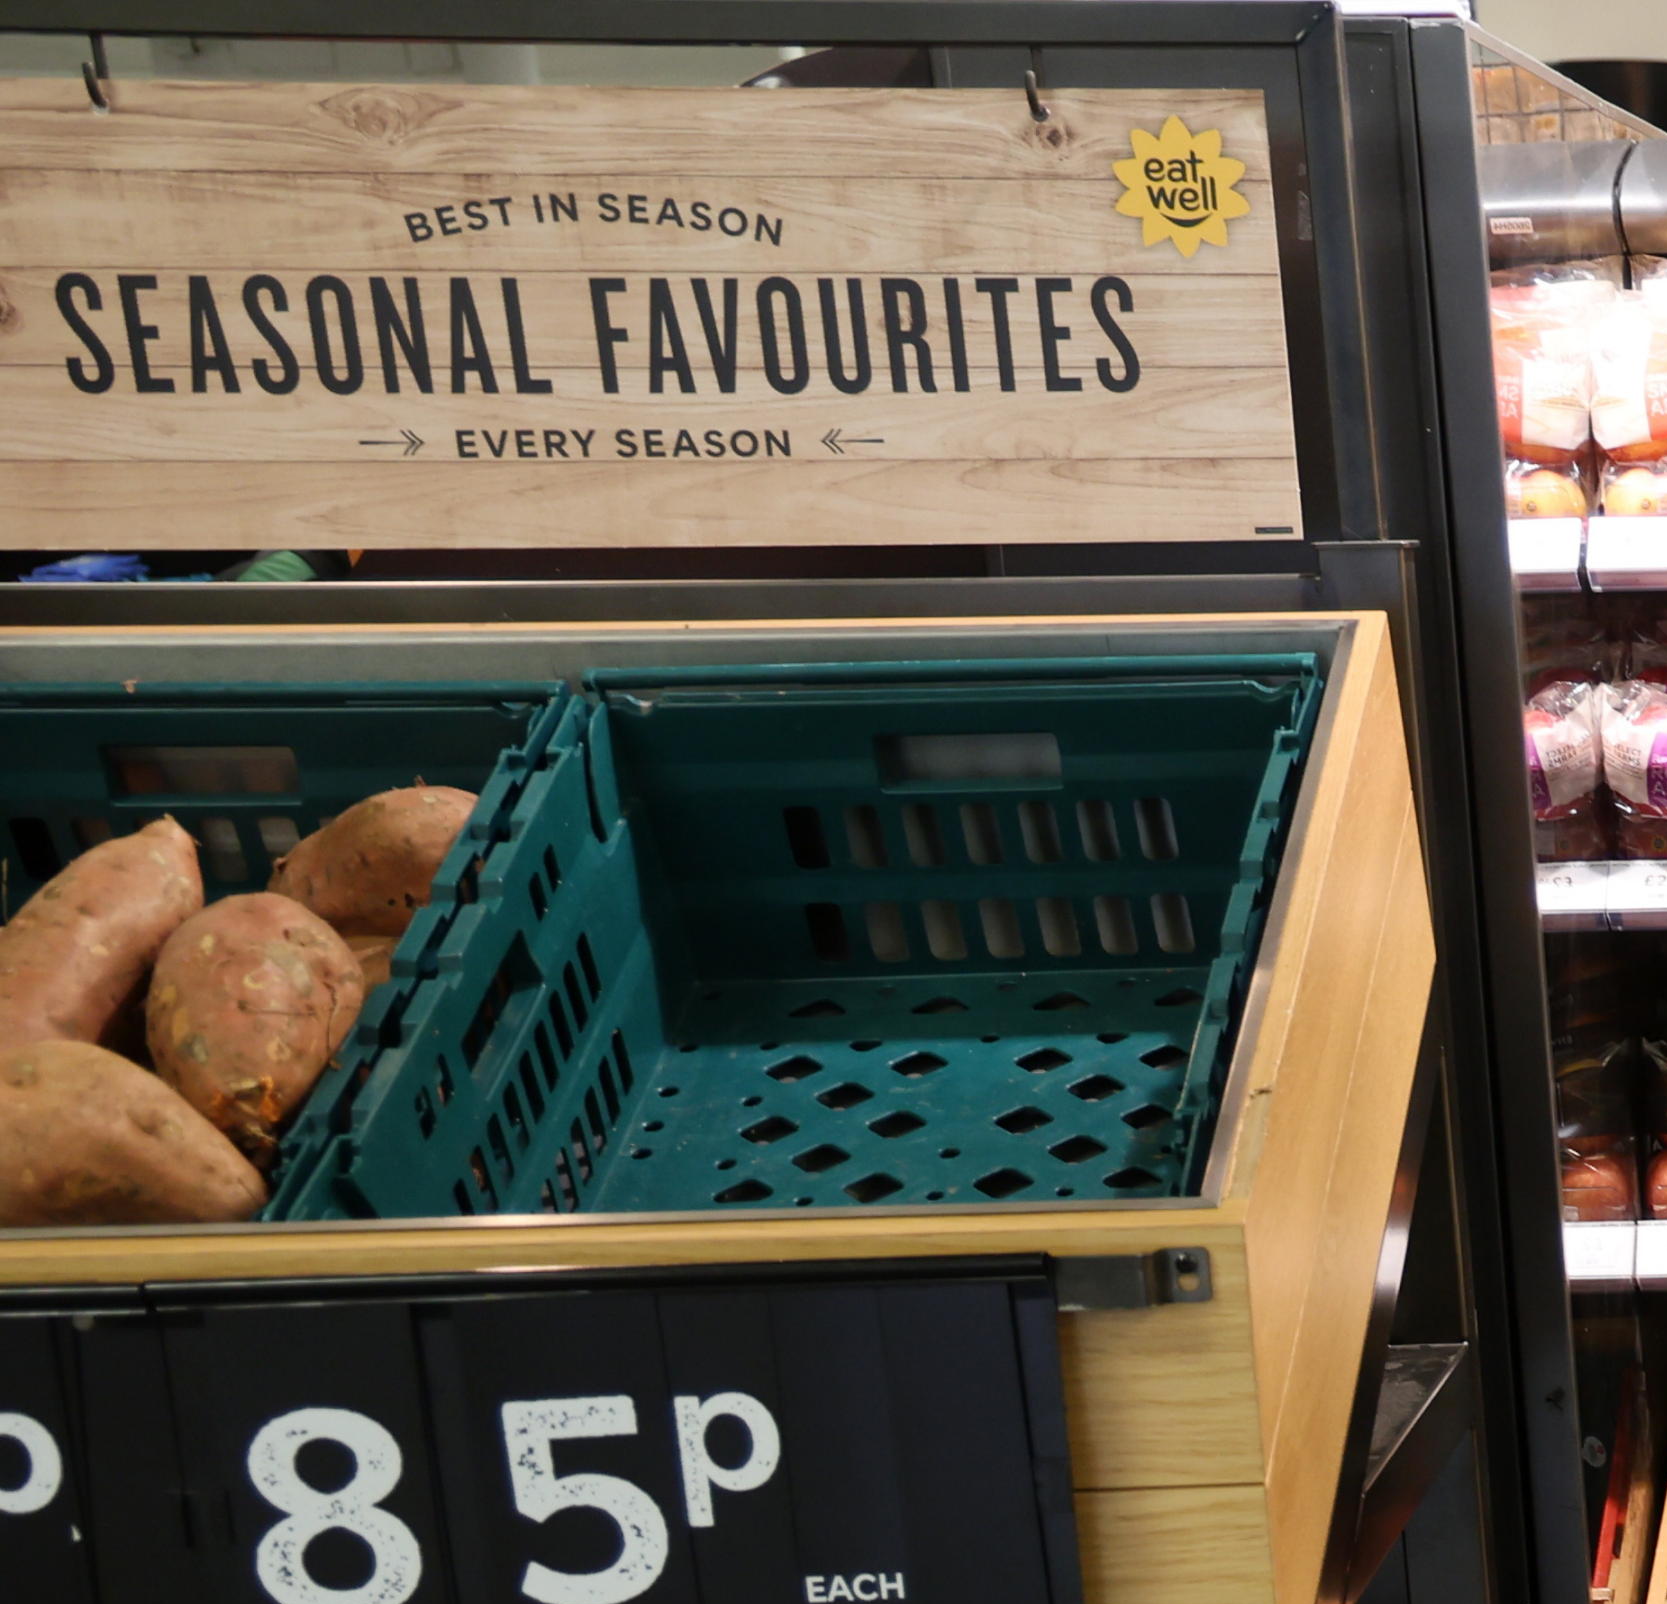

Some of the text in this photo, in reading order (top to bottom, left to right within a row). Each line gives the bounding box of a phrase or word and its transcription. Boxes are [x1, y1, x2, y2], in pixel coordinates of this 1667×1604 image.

[1143, 150, 1204, 184] eat
[1146, 175, 1218, 213] well
[404, 193, 783, 246] BEST IN SEASON
[55, 272, 1141, 396] SEASONAL FAVOURITES
[455, 429, 791, 458] EVERY SEASON
[805, 1572, 906, 1603] EACH
